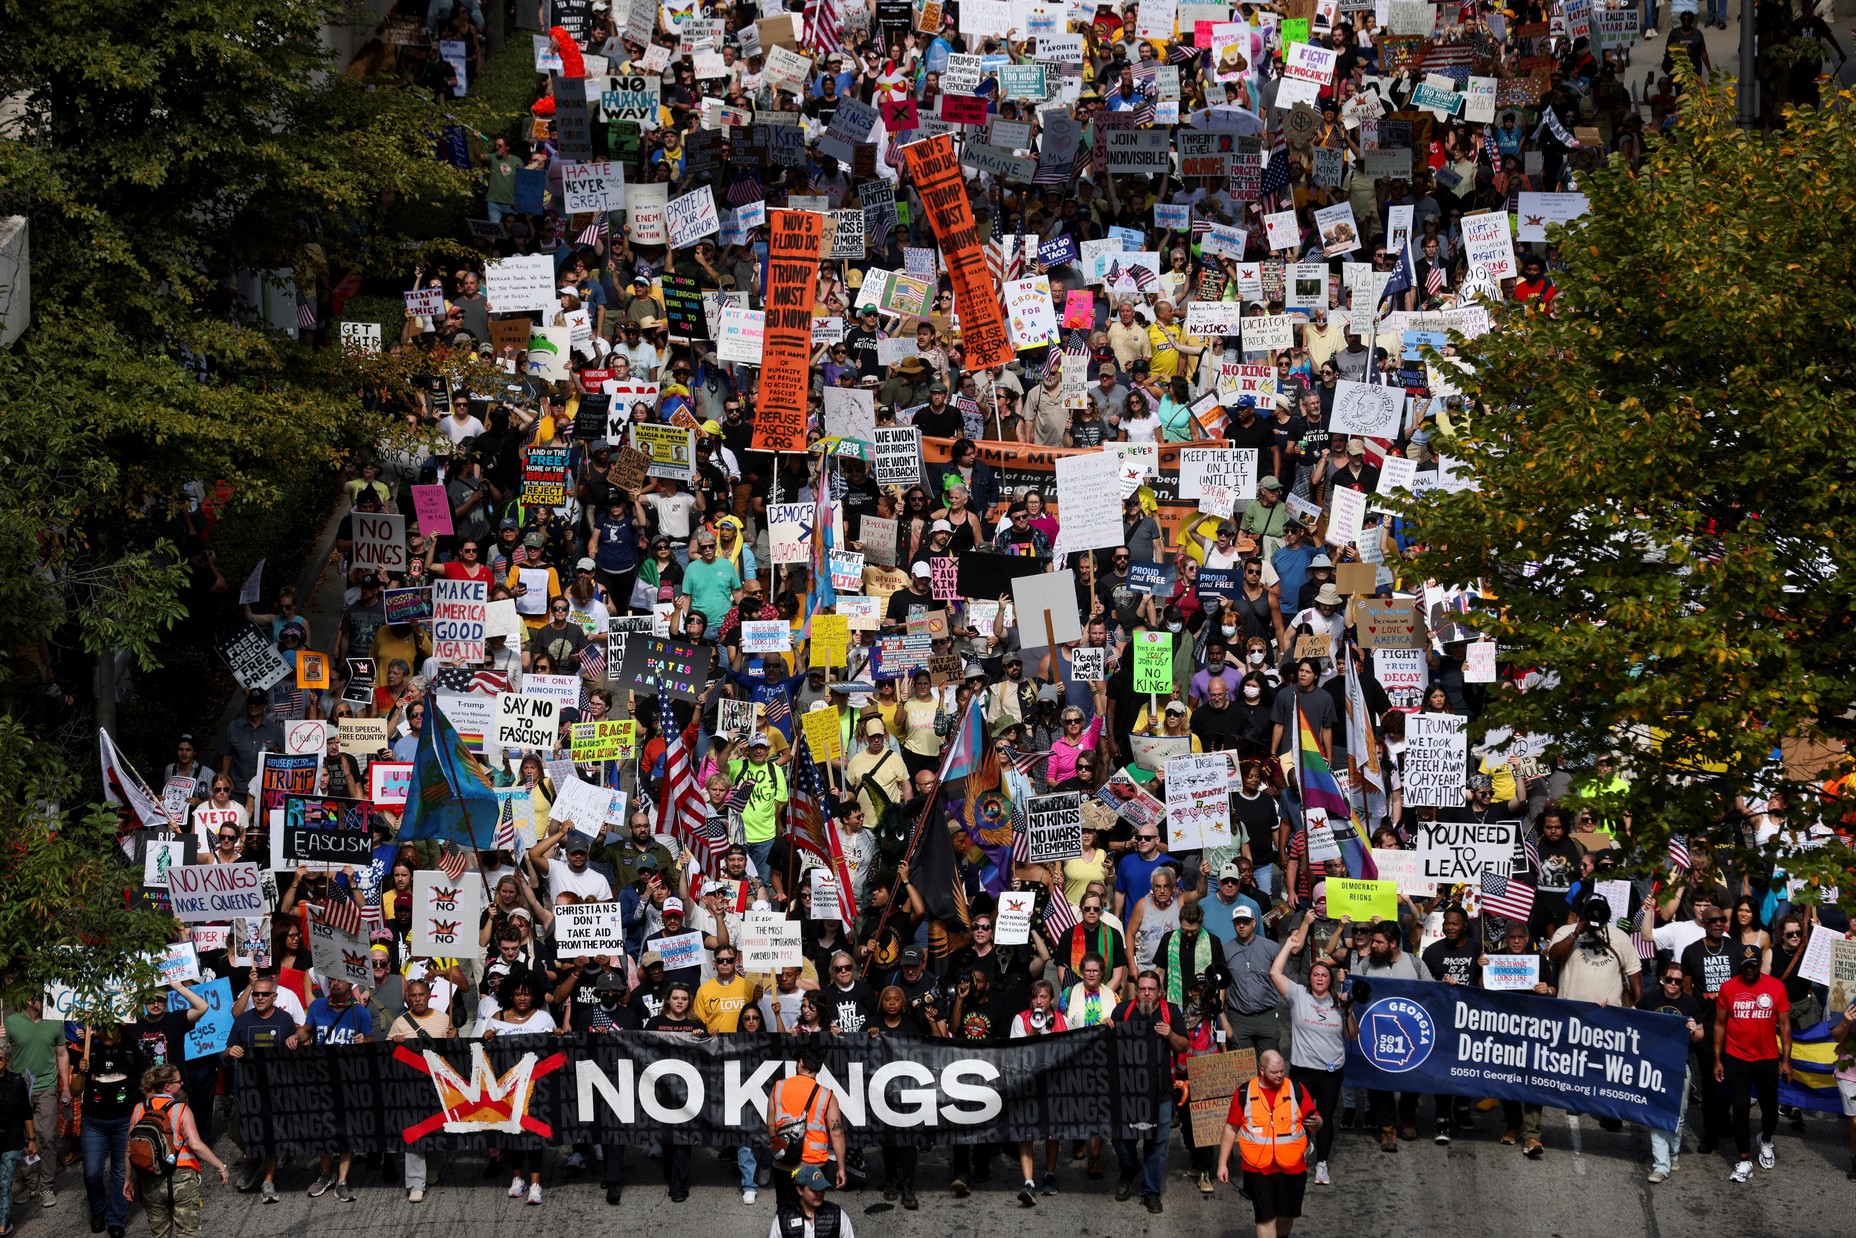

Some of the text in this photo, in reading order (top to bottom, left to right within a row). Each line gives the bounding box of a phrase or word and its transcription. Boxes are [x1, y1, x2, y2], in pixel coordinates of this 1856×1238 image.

[1042, 44, 1078, 52] FAVORITE
[949, 57, 972, 66] TRUMP
[1300, 47, 1329, 66] FIGHT
[1004, 72, 1040, 81] TOO HIGH?
[1285, 64, 1331, 85] DEMOCRACY!
[611, 77, 646, 91] NO
[1472, 82, 1493, 94] Free
[602, 107, 656, 122] WAY!
[1111, 134, 1137, 145] JOIN
[1181, 134, 1215, 145] THREAT
[1184, 144, 1212, 154] LEVEL
[1106, 151, 1168, 165] INDIVISIBLE!
[1232, 154, 1261, 164] THE AXE
[1316, 151, 1341, 160] TRUMP
[565, 163, 611, 178] HATE
[1182, 158, 1224, 175] ORANGE
[1231, 165, 1261, 176] FORGETS
[1316, 165, 1339, 175] KING
[565, 179, 605, 194] NEVER
[1245, 181, 1261, 190] TREE
[861, 189, 892, 205] UNITED
[1231, 190, 1261, 201] REMEMBERS
[666, 188, 710, 219] PROTECT
[636, 213, 661, 222] ENEMY
[681, 212, 698, 227] OUR
[784, 217, 799, 231] NOV
[636, 230, 660, 239] WITHIN
[671, 217, 718, 248] NEIGHBORS
[1468, 230, 1500, 242] RIGHT
[773, 236, 803, 250] FLOOD
[1046, 246, 1067, 259] TACO
[772, 264, 810, 284] TRUMP
[405, 290, 442, 299] PREDATOR
[774, 287, 805, 306] MUST
[1012, 294, 1046, 306] CROWN
[1243, 316, 1292, 329] DICTATOR?
[342, 324, 370, 334] GET
[1221, 364, 1271, 377] NO KING
[1242, 379, 1256, 390] IN
[760, 411, 798, 426] REFUSE
[755, 424, 804, 437] FASCISM
[875, 428, 914, 442] WE WON
[1303, 434, 1328, 442] MEXICO
[528, 449, 546, 457] LAND
[877, 443, 915, 454] OUR RIGHTS
[530, 456, 562, 466] FREE
[1184, 450, 1254, 461] KEEP THE HEAT
[877, 457, 916, 468] WE WON'T
[1207, 463, 1221, 473] ON
[526, 472, 563, 482] BRAVE
[896, 466, 917, 477] BACK!
[527, 487, 563, 495] REJECT
[522, 495, 565, 505] FASCISM!
[359, 519, 392, 540] NO
[355, 543, 402, 564] KINGS
[1132, 566, 1159, 576] PROUD
[1146, 576, 1165, 584] FREE
[1200, 574, 1227, 583] PROUD
[1215, 581, 1234, 589] FREE
[437, 583, 484, 600] MAKE
[434, 602, 486, 621] AMERICA
[436, 621, 482, 639] GOOD
[1374, 636, 1412, 644] AMERICA
[434, 641, 483, 659] AGAIN
[648, 640, 692, 657] TRUMP
[1074, 649, 1100, 665] People
[1382, 650, 1418, 659] FIGHT
[648, 659, 691, 674] HATES
[1385, 662, 1416, 670] TRUTH
[1145, 668, 1160, 679] NO
[1384, 673, 1421, 682] DECAY
[527, 687, 573, 696] MINORITIES
[503, 697, 552, 718] SAY NO
[600, 723, 630, 737] RAGE
[500, 727, 552, 746] FASCISM
[1425, 737, 1451, 748] TOOK
[1405, 748, 1451, 759] FREEDOM
[1405, 760, 1465, 772] SPEECH AWAY
[1428, 772, 1460, 785] YEAH?
[1169, 787, 1226, 802] MORE WARMTH!
[1029, 809, 1079, 827] NO KINGS
[158, 832, 176, 842] RIP
[1030, 826, 1080, 842] NO WARS
[1462, 826, 1510, 842] NEED
[295, 832, 372, 856] FASCISM
[1031, 840, 1080, 854] NO EMPIRES
[1451, 847, 1476, 861] TO
[167, 867, 257, 894] NO KINGS
[1342, 882, 1378, 890] DEMOCRACY
[1350, 893, 1372, 901] REIGNS
[174, 895, 261, 913] MORE QUEENS
[435, 902, 454, 911] NO
[556, 905, 617, 916] CHRISTIANS
[435, 934, 454, 943] NO
[567, 928, 611, 938] TAKE AID
[557, 939, 623, 949] FROM THE POOR
[769, 938, 801, 946] IMMIGRANTS
[1443, 957, 1472, 967] RACISM
[1704, 956, 1729, 965] HATE
[1495, 967, 1527, 975] DEMOCRACY
[1704, 964, 1730, 973] NEVER
[720, 999, 745, 1010] LOVE
[1752, 1009, 1772, 1019] HELL!
[1389, 1002, 1429, 1046] GEORGIA
[1455, 1002, 1640, 1054] Democracy Doesn't
[1459, 1034, 1530, 1068] Defend
[1639, 1062, 1666, 1093] Do.
[1451, 1067, 1647, 1105] 50501 Georgia 50501ga.org #50501GA
[576, 1059, 1003, 1126] NO KNGS
